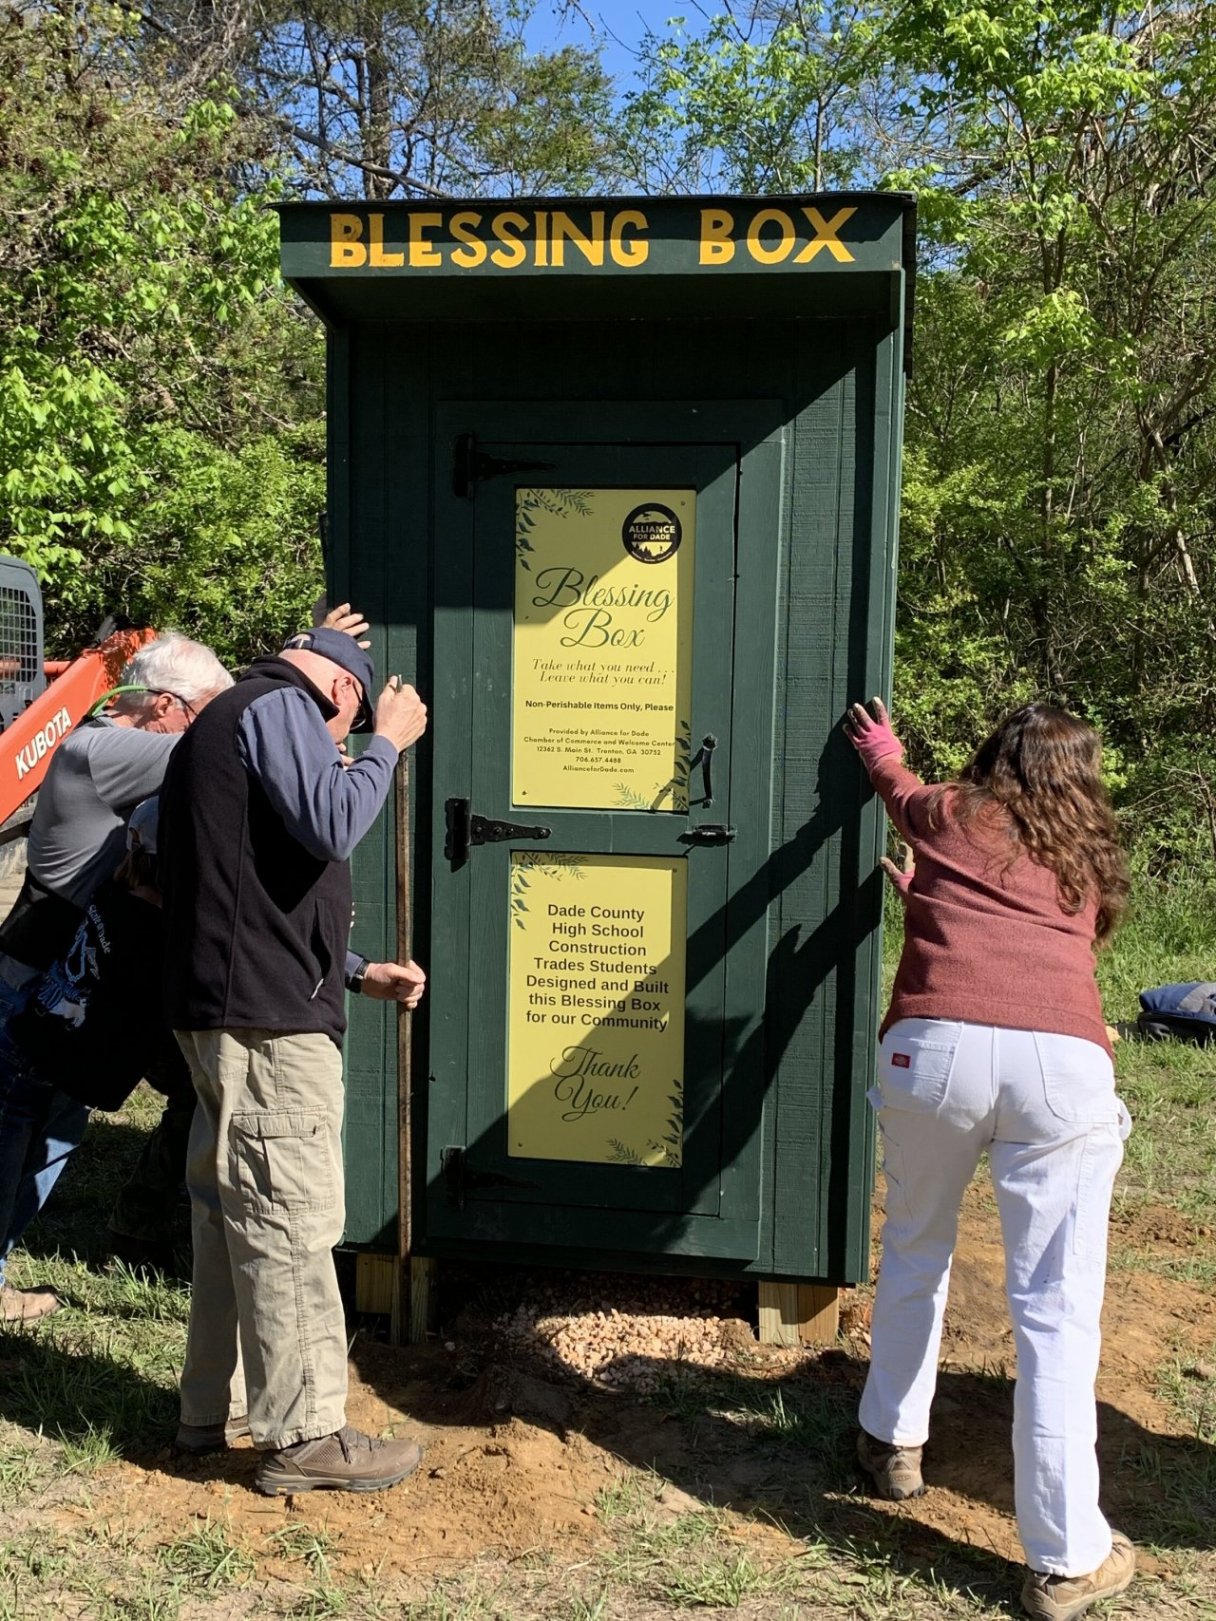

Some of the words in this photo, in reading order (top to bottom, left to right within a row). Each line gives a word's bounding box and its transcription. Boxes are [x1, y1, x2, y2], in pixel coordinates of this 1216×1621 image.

[329, 210, 650, 269] BLESSING
[699, 207, 860, 266] BOX
[628, 525, 676, 534] ALLIANCE
[633, 533, 648, 541] FOR
[649, 533, 671, 541] DADE
[532, 567, 673, 623] Blessing
[560, 608, 646, 649] Box
[532, 658, 563, 671] Take
[566, 660, 597, 672] what
[599, 663, 622, 675] you
[539, 670, 576, 683] Leave
[579, 672, 609, 684] what
[612, 674, 634, 687] you
[637, 674, 667, 685] can!
[525, 699, 592, 710] Non-Perishable
[593, 701, 619, 711] Items
[619, 702, 643, 713] Only,
[644, 702, 674, 712] Please
[549, 727, 579, 735] Provided
[580, 728, 589, 737] by
[619, 729, 630, 737] for
[15, 706, 73, 781] KUBOTA
[564, 737, 602, 745] Commerce
[651, 740, 676, 748] Center
[640, 748, 662, 756] 30752
[562, 764, 635, 773] AllianceforDade.com
[547, 904, 586, 918] Dade
[590, 905, 646, 922] County
[552, 922, 587, 937] High
[591, 924, 645, 938] School
[548, 940, 648, 957] Construction
[534, 957, 586, 972] Trades
[589, 958, 658, 975] Students
[526, 975, 597, 992] Designed
[600, 977, 629, 992] and
[633, 980, 670, 995] Built
[528, 993, 557, 1007] this
[560, 994, 627, 1012] Blessing
[631, 998, 662, 1012] Box
[526, 1010, 547, 1024] for
[551, 1013, 578, 1026] our
[580, 1013, 669, 1034] Community
[549, 1045, 641, 1080] Thank
[553, 1073, 640, 1123] You!
